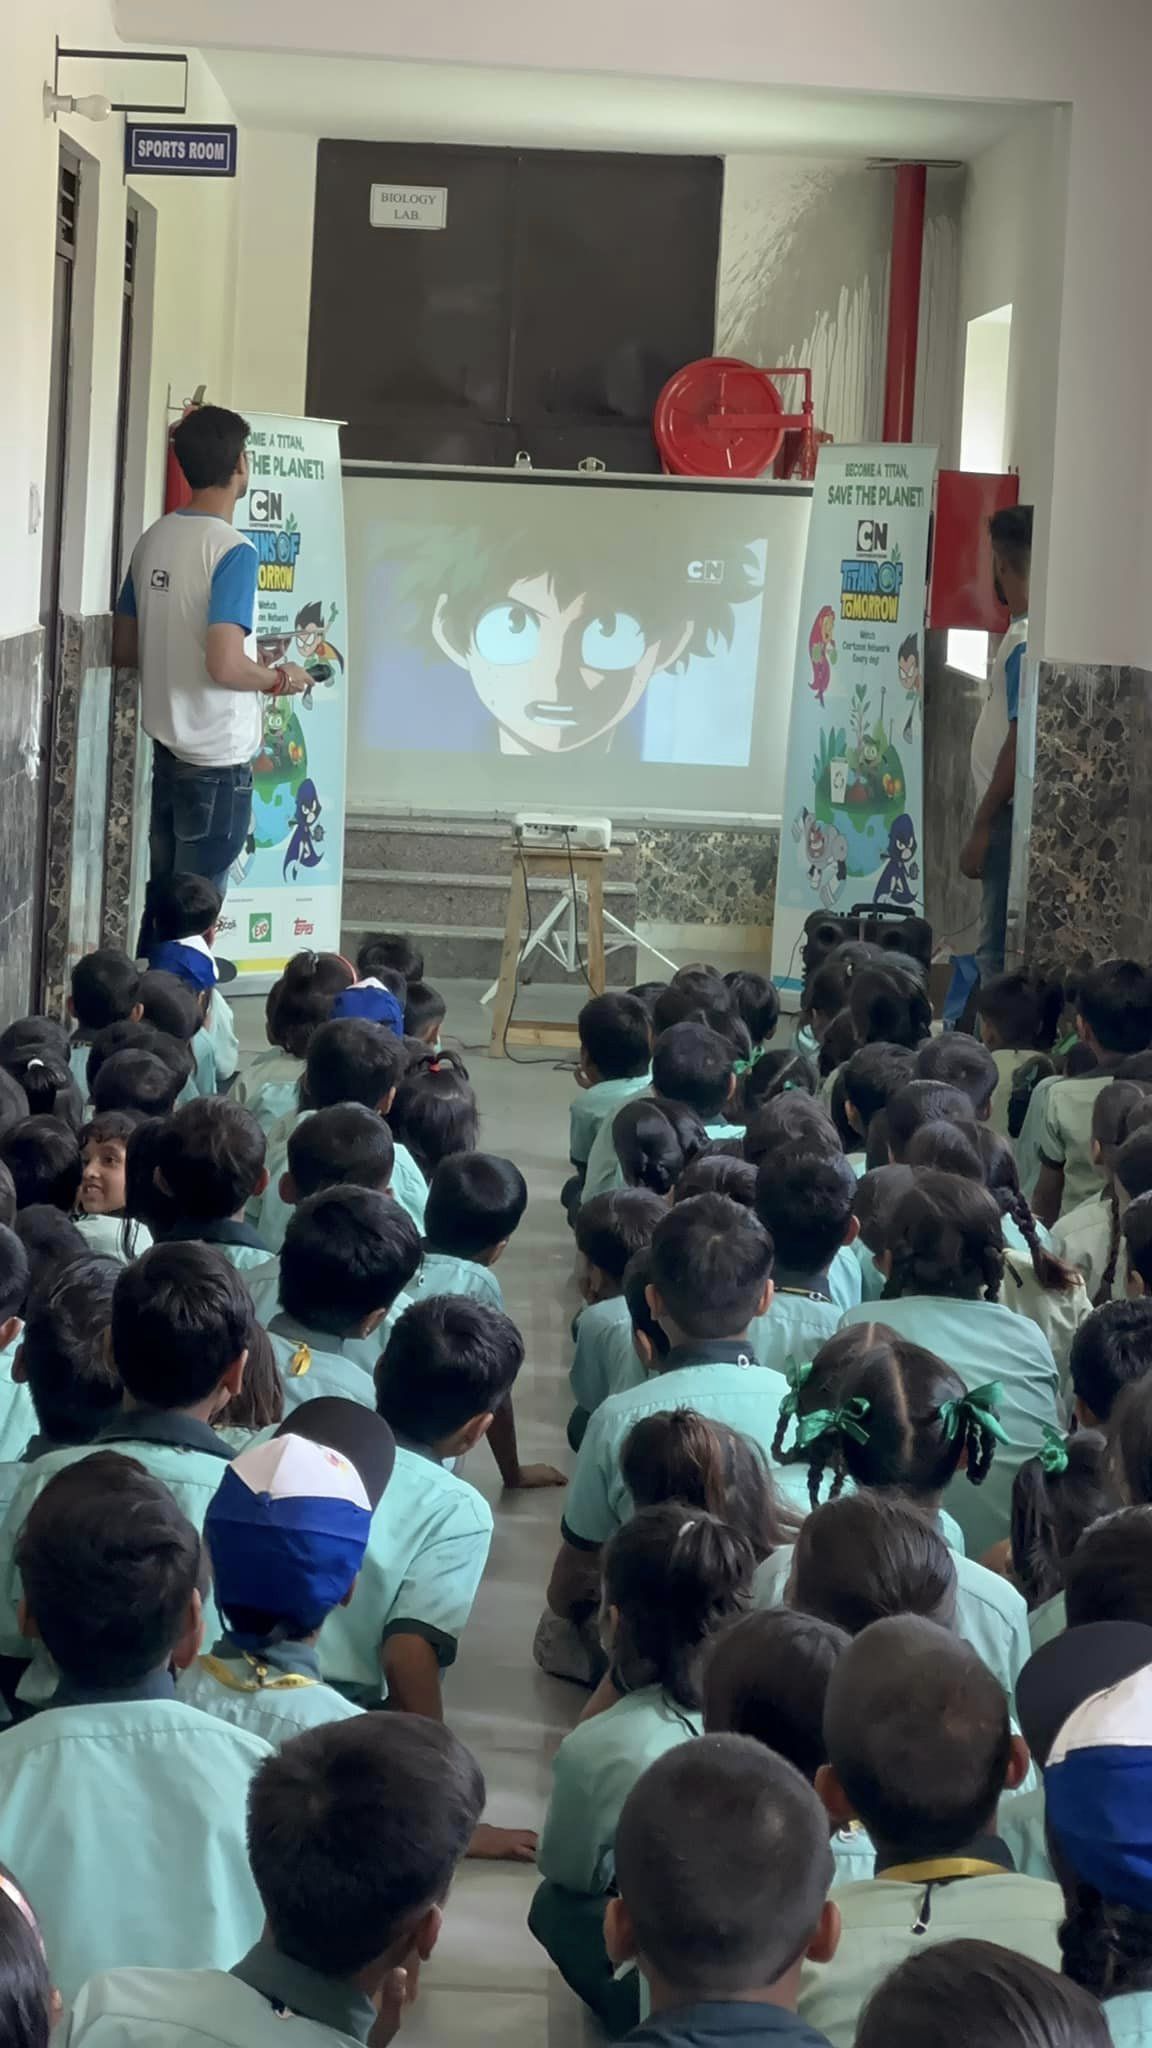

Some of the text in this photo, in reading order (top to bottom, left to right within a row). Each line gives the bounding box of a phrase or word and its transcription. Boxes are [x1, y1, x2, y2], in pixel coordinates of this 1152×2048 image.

[138, 139, 225, 160] SPORTS ROOM
[381, 192, 437, 205] BIOLOGY
[269, 433, 276, 447] A
[252, 454, 324, 480] HE PLANET!
[845, 463, 875, 477] BECOME
[876, 464, 882, 477] A
[249, 489, 282, 521] CN
[828, 485, 853, 505] SAVE
[855, 485, 877, 506] THE
[857, 520, 888, 552] CN
[258, 563, 295, 592] ORROW
[687, 560, 724, 580] CN
